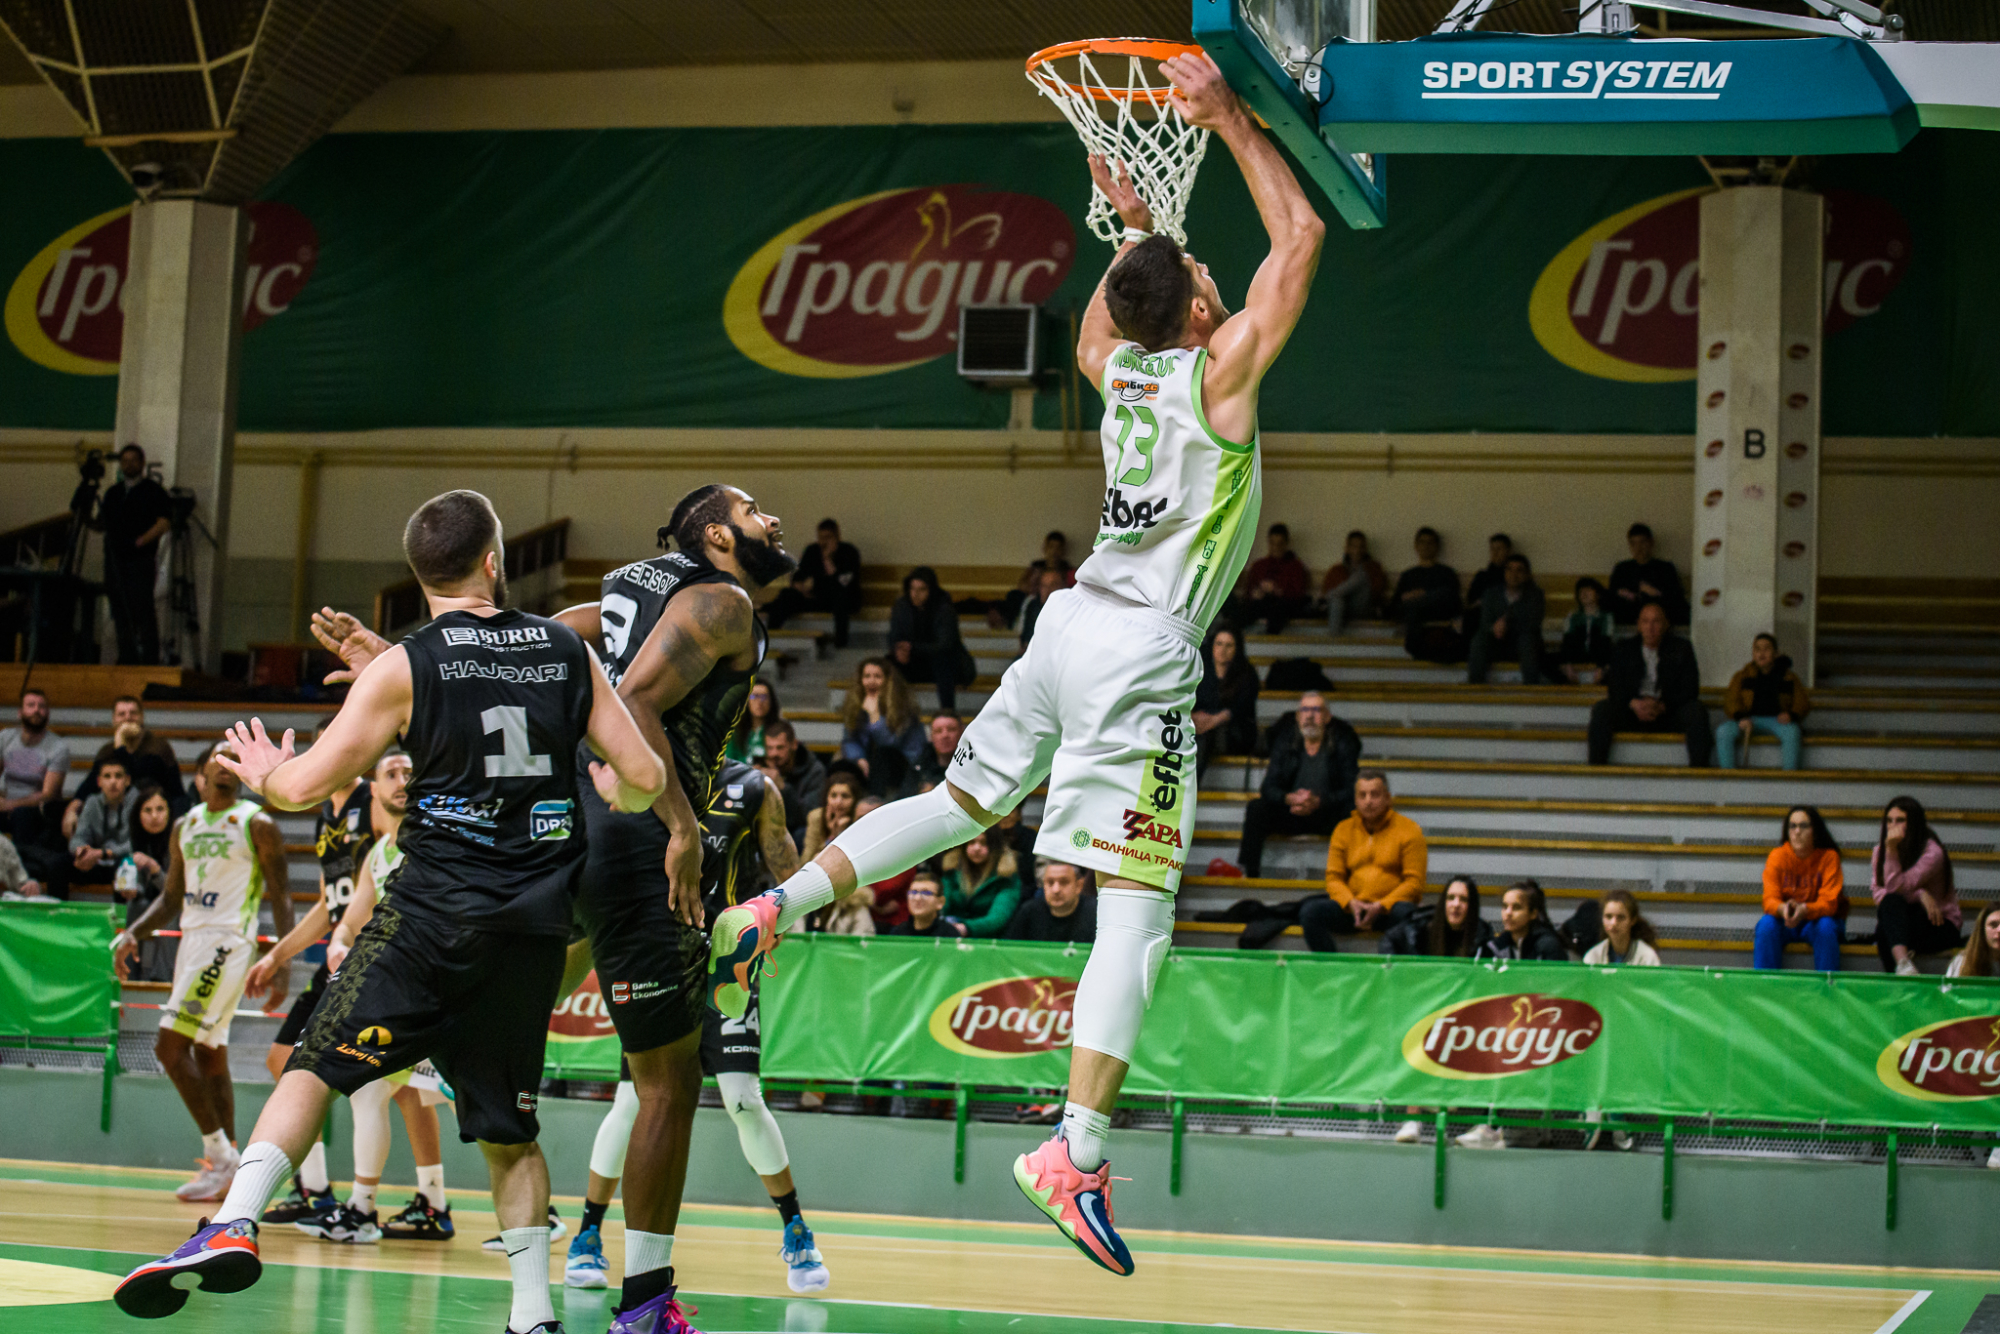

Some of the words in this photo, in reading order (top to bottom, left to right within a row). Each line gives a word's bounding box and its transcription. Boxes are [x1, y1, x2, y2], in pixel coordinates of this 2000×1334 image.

[477, 627, 550, 645] BURRI
[438, 660, 568, 683] HAJDARI
[480, 704, 553, 778] 1
[1153, 709, 1184, 811] efbet
[1092, 838, 1151, 863] БОЛНИЦА
[951, 996, 1073, 1046] Граду
[1424, 1016, 1593, 1065] Градус
